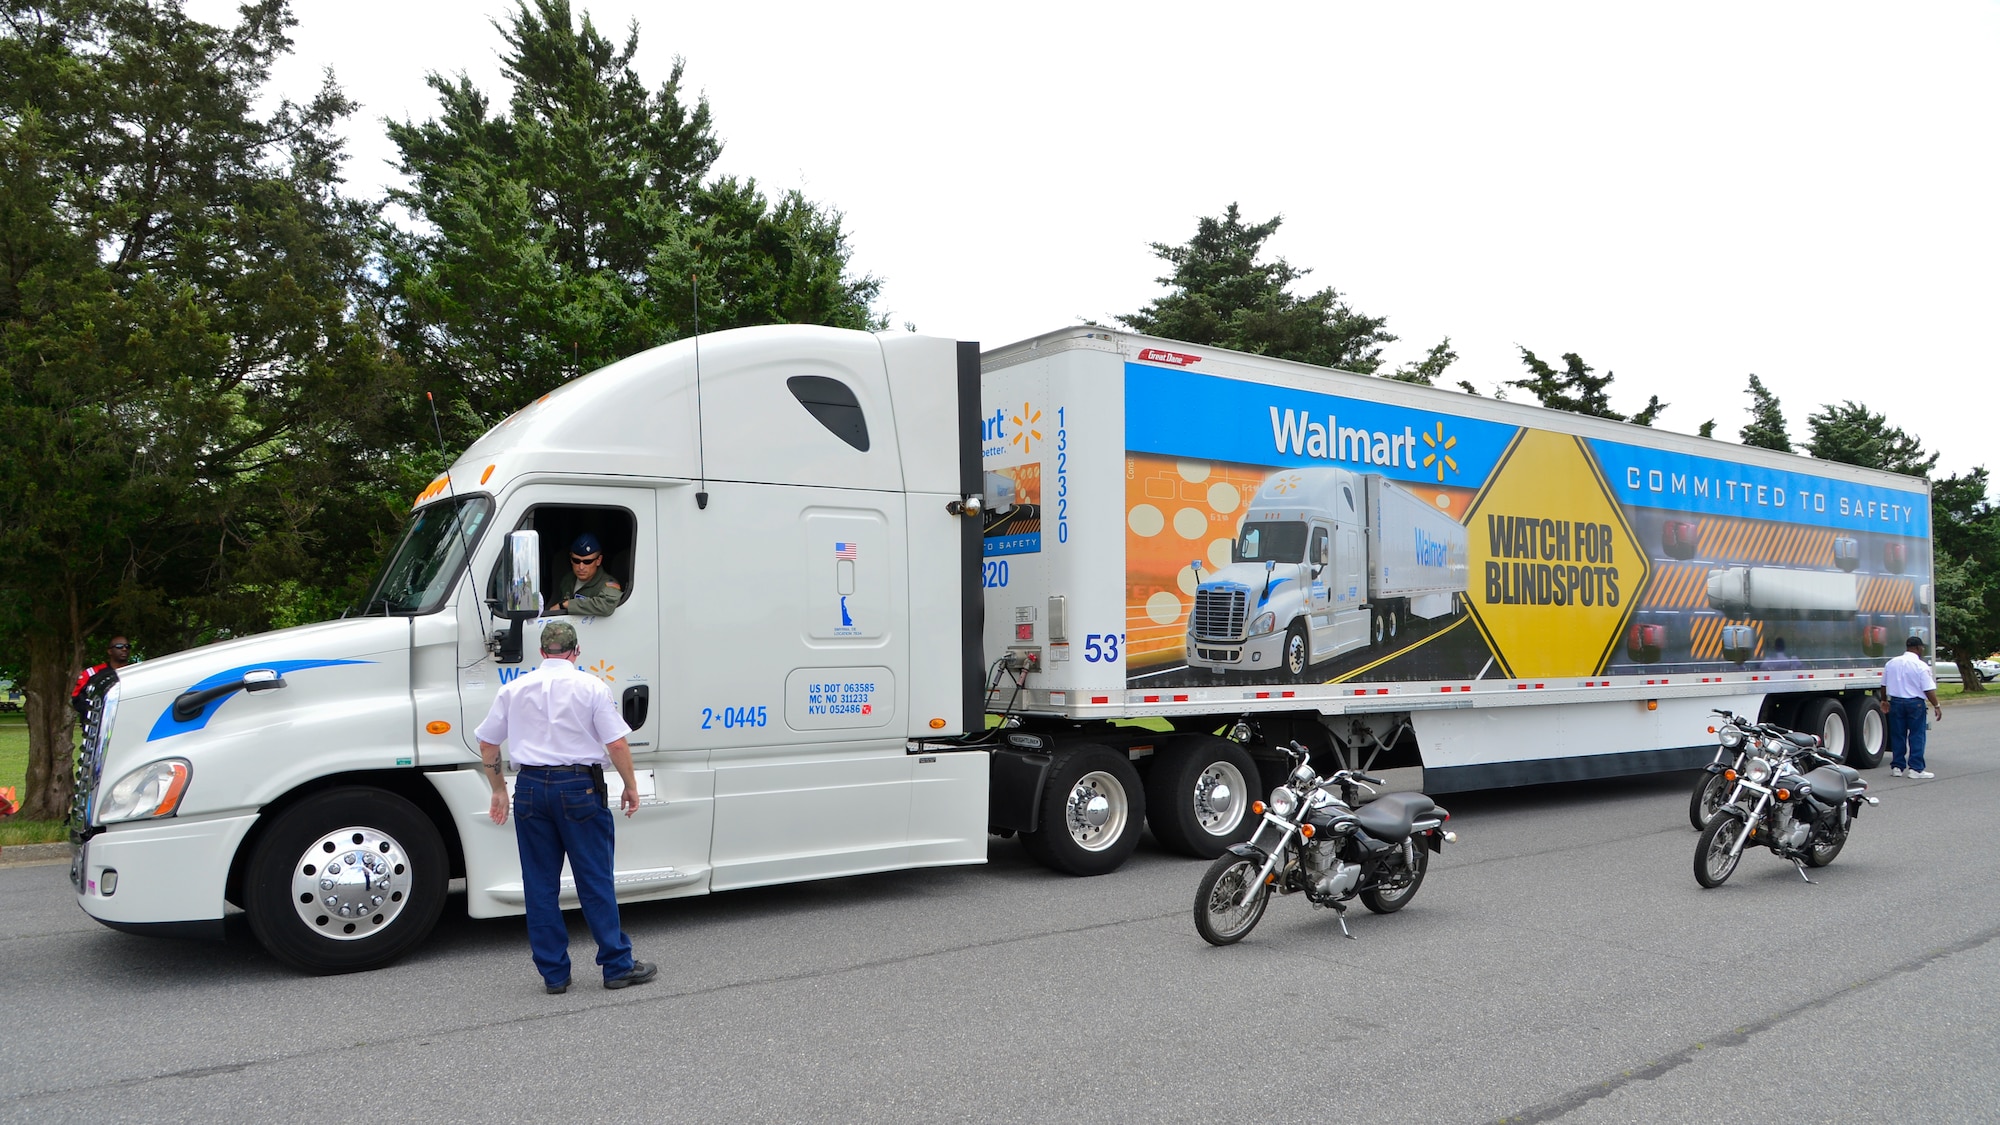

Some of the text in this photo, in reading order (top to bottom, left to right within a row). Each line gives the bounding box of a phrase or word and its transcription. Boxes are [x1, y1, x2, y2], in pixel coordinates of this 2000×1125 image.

[1148, 350, 1183, 364] Great Dane
[1269, 406, 1417, 470] Walmart
[1627, 466, 1912, 523] COMMITTED TO SAFETY
[999, 538, 1037, 550] SAFETY
[1414, 526, 1448, 567] Walmart
[1488, 514, 1613, 563] WATCH FOR
[1485, 561, 1619, 607] BLINDSPOTS
[809, 683, 875, 693] US DOT 063585
[809, 693, 868, 704] MC NO 311233
[808, 704, 860, 714] KYU 052486
